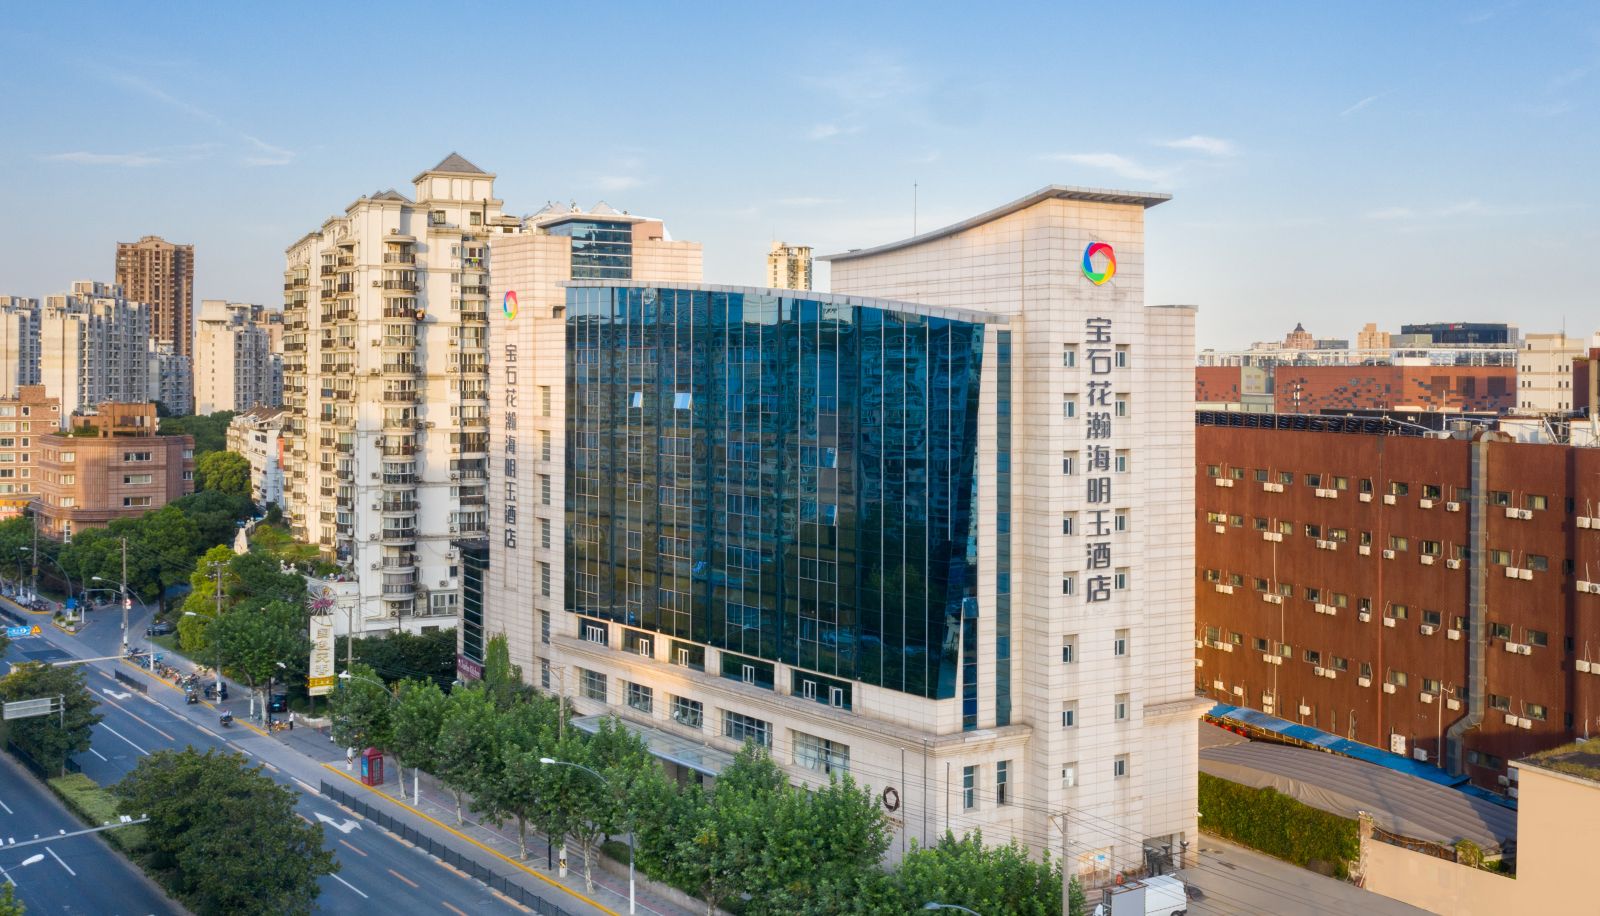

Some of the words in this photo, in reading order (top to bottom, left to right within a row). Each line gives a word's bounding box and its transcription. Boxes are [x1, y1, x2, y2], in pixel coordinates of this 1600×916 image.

[504, 344, 517, 548] 宝石花瀚海明玉酒店
[1086, 317, 1112, 603] 宝石花瀚海明玉酒店
